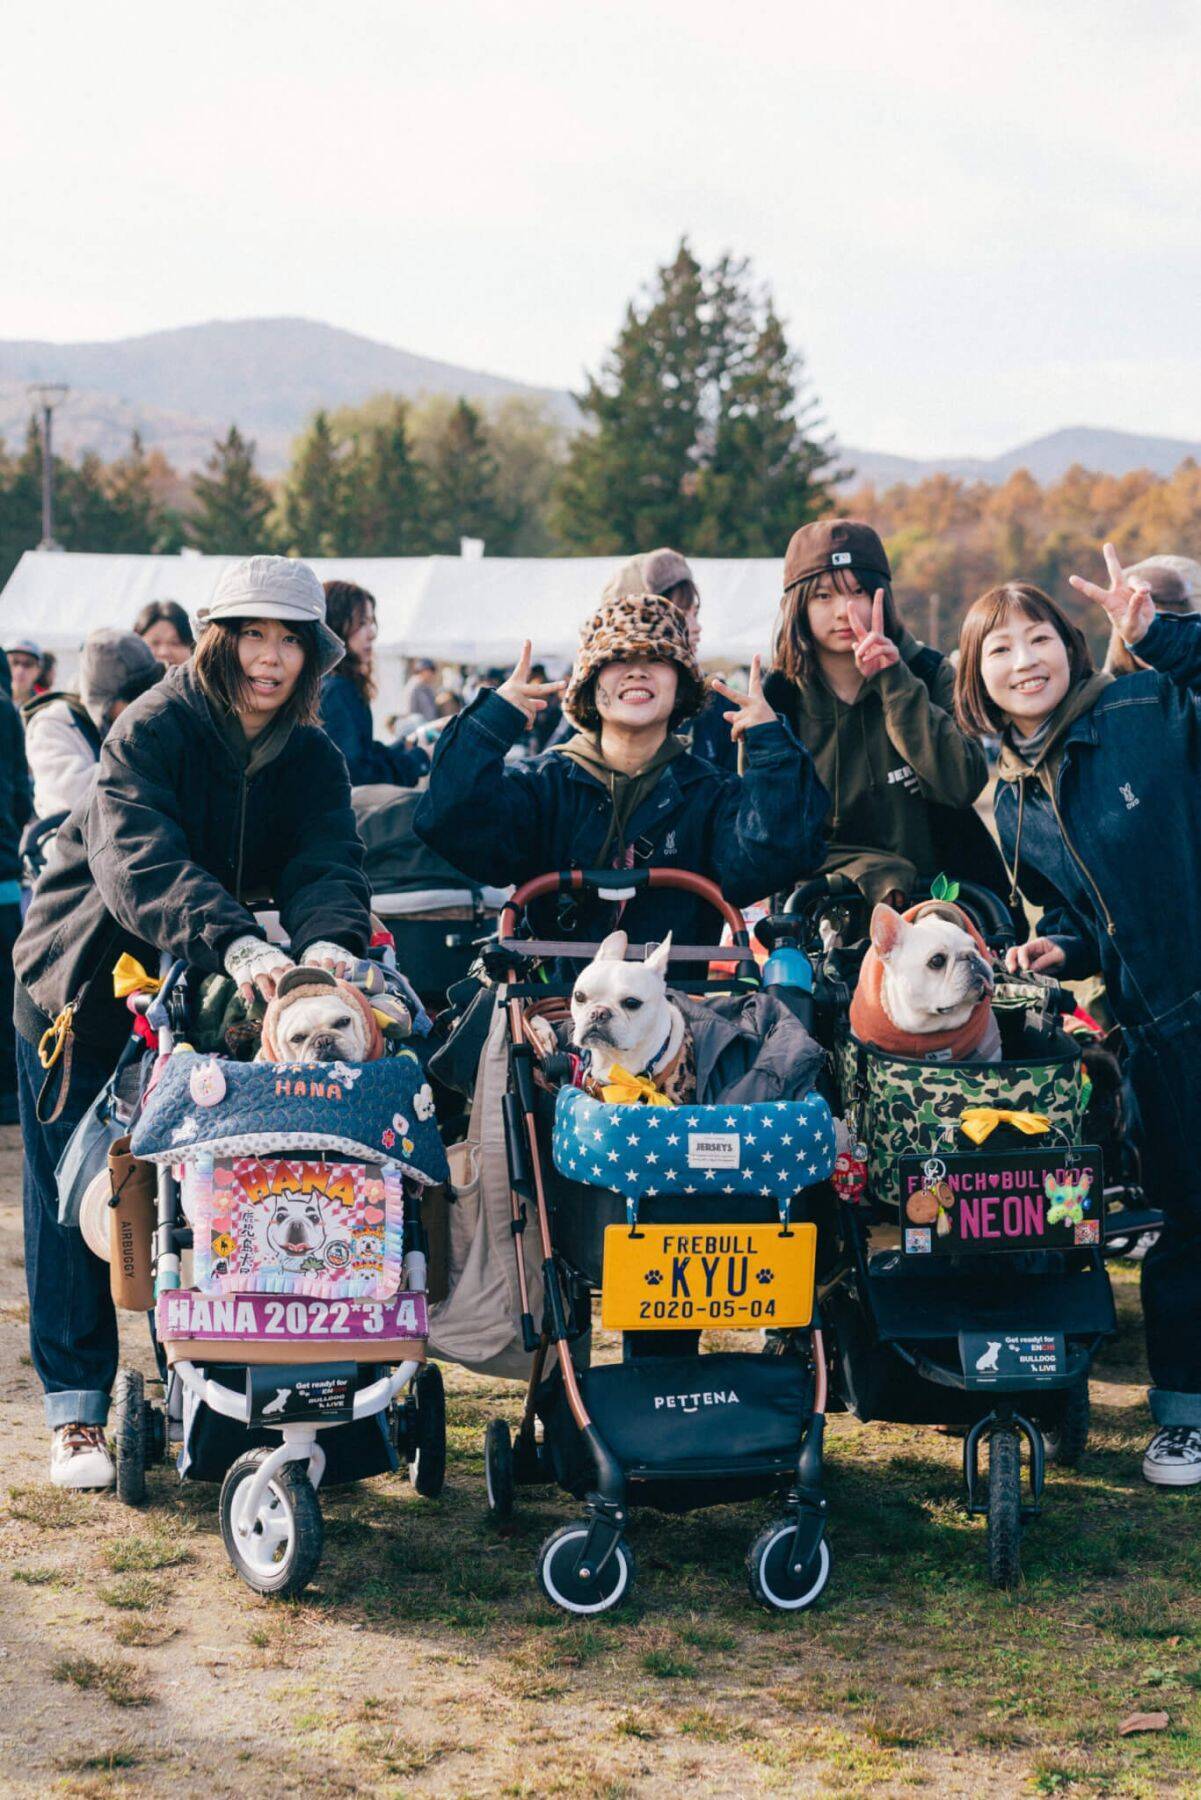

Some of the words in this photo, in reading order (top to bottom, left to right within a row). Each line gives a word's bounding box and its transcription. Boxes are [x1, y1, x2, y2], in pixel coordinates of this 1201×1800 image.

[275, 1079, 342, 1101] HANA
[696, 1143, 733, 1152] JERSEYS
[238, 1161, 356, 1207] HANA
[907, 1173, 987, 1194] FNCH
[960, 1195, 1045, 1239] NEON
[121, 1221, 136, 1279] AIRBUGGY
[663, 1236, 758, 1254] FREBULL
[671, 1256, 748, 1298] KYU
[167, 1300, 258, 1333] HANA
[640, 1300, 776, 1319] 2020-05-04
[1039, 1364, 1056, 1372] LIVE
[653, 1390, 740, 1411] PETTENA
